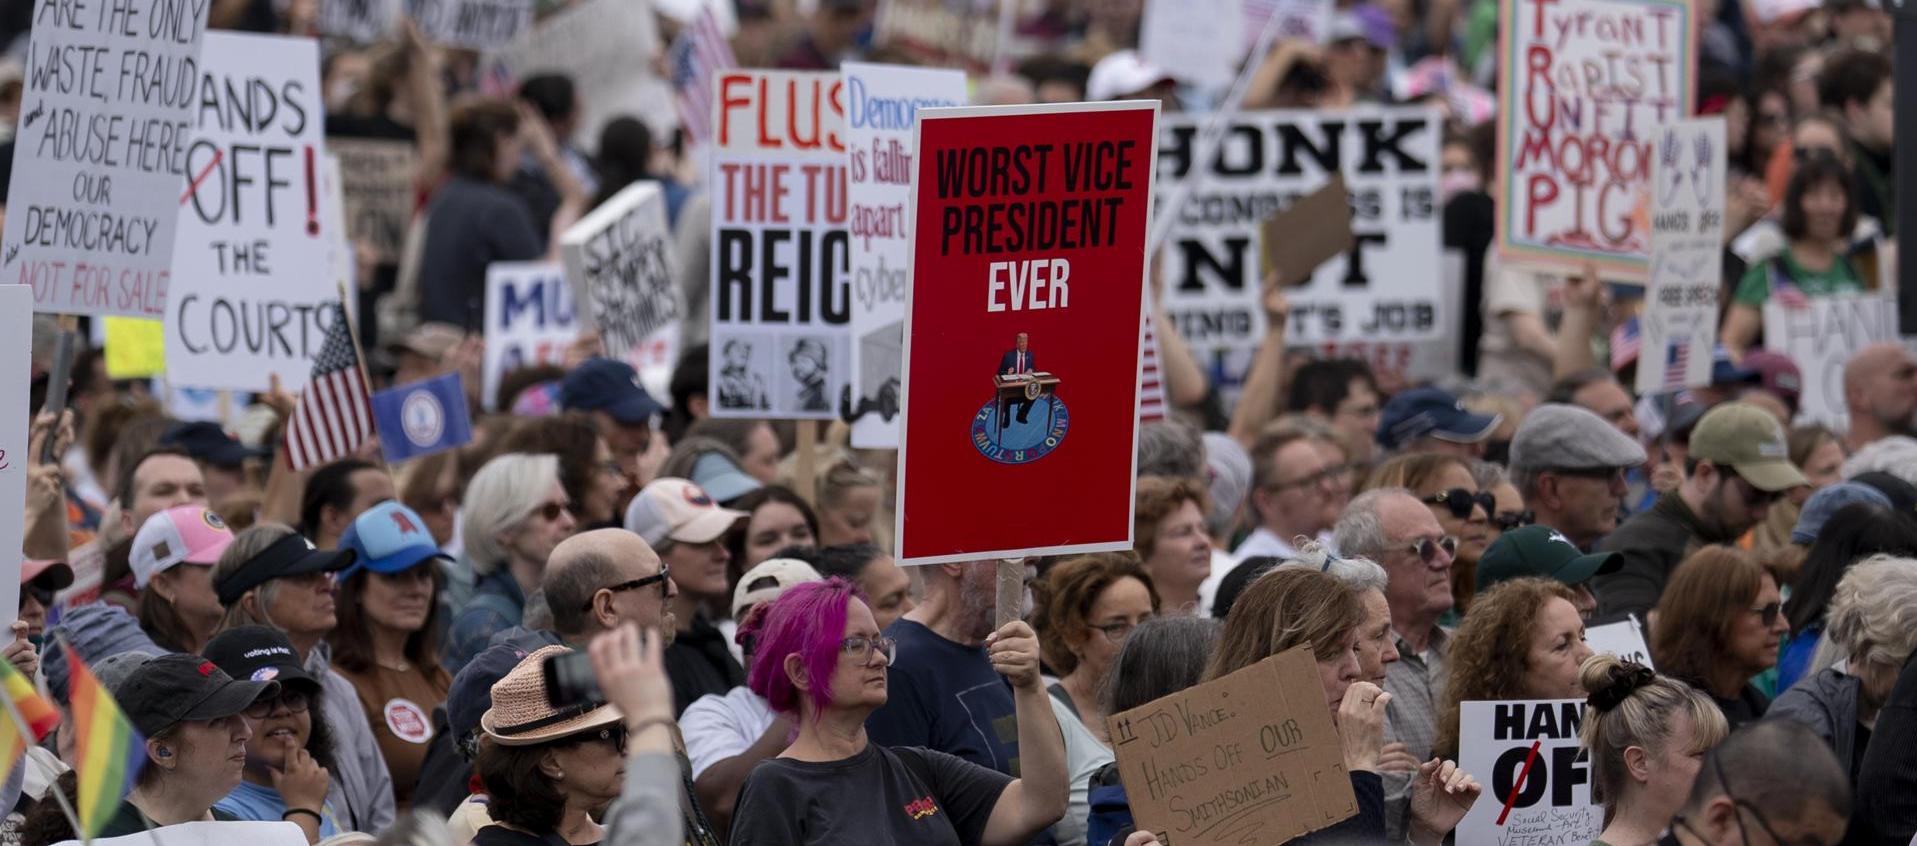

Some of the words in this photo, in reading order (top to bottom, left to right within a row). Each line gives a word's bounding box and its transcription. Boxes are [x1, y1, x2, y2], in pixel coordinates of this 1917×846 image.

[36, 0, 85, 31] ARE
[97, 0, 138, 36] THE
[149, 0, 203, 44] ONLY
[117, 50, 197, 110] FRAUD
[199, 72, 305, 137] ANDS
[37, 108, 122, 167] ABUSE
[718, 74, 845, 152] FLUS
[72, 169, 112, 206] OUR
[851, 144, 867, 183] is
[872, 137, 912, 185] fallin
[936, 145, 1053, 199] WORST
[1063, 140, 1136, 193] VICE
[719, 164, 791, 224] THE
[800, 166, 849, 225] TU
[24, 205, 159, 257] DEMOCRACY
[851, 202, 906, 251] apart
[942, 198, 1124, 256] PRESIDENT
[18, 259, 66, 303] NOT
[70, 262, 112, 308] FOR
[117, 267, 171, 315] SALE
[210, 241, 271, 276] THE
[718, 229, 851, 326] REIC
[986, 257, 1071, 313] EVER
[1176, 231, 1388, 293] NT
[1360, 302, 1435, 333] JOB
[243, 648, 271, 658] voting
[1137, 708, 1178, 748] JD
[1494, 702, 1586, 740] HAN
[1142, 756, 1209, 801] HANDS
[1213, 742, 1244, 771] OFF
[1259, 718, 1304, 754] OUR
[1492, 746, 1602, 809] OF
[1168, 770, 1290, 833] SMITHSONIAN
